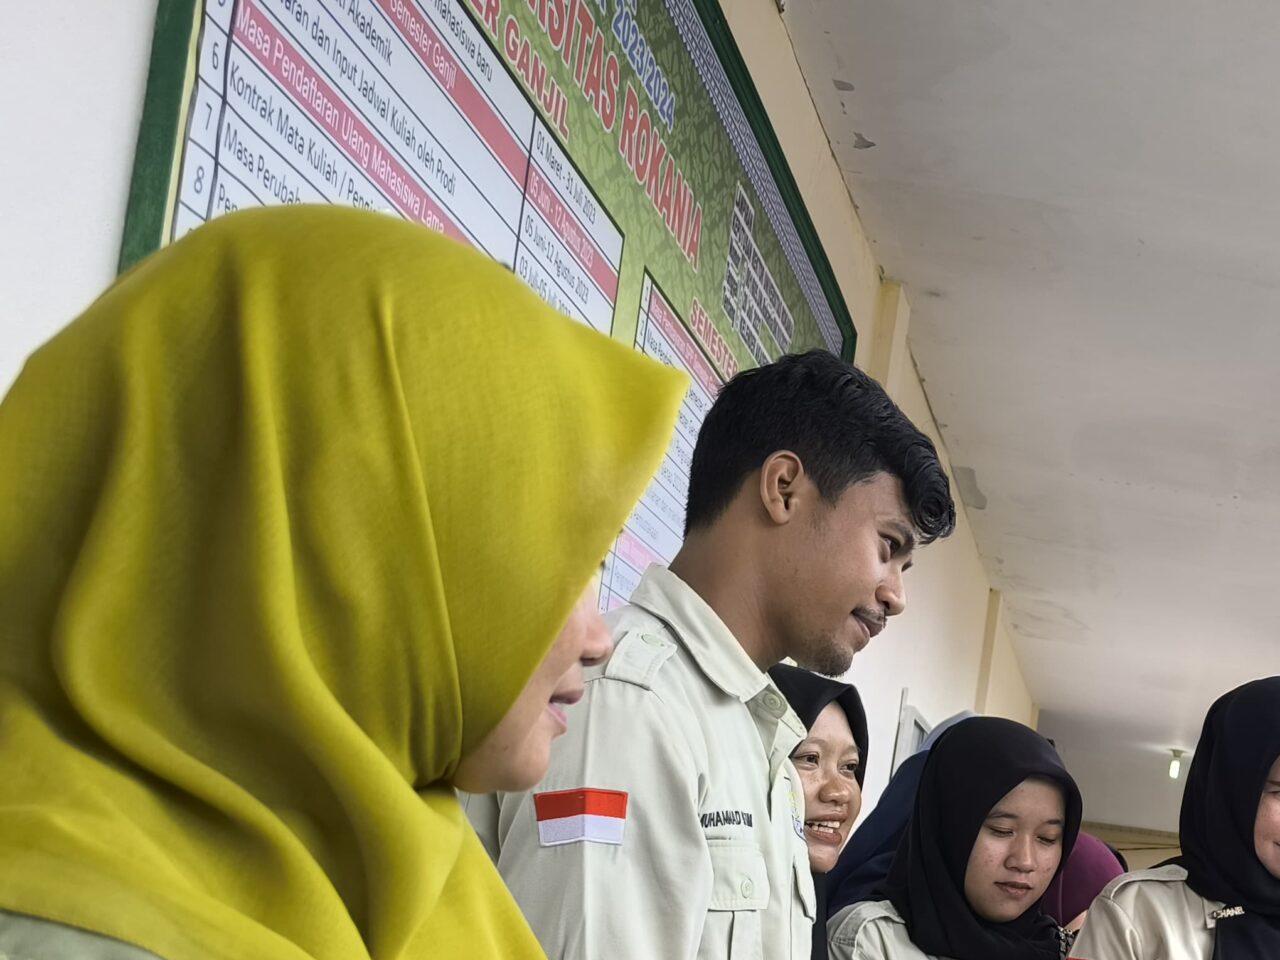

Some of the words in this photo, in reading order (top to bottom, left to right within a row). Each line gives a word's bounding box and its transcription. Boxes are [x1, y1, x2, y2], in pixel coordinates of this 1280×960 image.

[348, 2, 392, 67] Akademik
[432, 42, 457, 89] Ganjil
[476, 43, 493, 83] baru
[504, 16, 569, 143] GANJIL
[205, 102, 212, 131] 7
[224, 122, 253, 173] Masa
[256, 155, 303, 205] Perubah
[212, 42, 219, 70] 6
[229, 61, 275, 126] Kontrak
[276, 107, 304, 155] Mata
[306, 137, 338, 188] Kuliah
[236, 2, 271, 57] Masa
[273, 38, 340, 131] Pendaftaran
[341, 111, 370, 168] Ulang
[371, 144, 420, 216] Mahasiswa
[421, 197, 444, 234] Lama
[311, 15, 331, 56] dan
[332, 38, 358, 87] Input
[357, 70, 390, 119] Jadwal
[390, 105, 416, 153] Kuliah
[417, 140, 435, 173] oleh
[436, 159, 456, 197] Prodi
[527, 0, 619, 133] SITAS
[618, 81, 703, 273] ROKANIA
[194, 165, 204, 194] 8
[536, 131, 545, 156] 01
[545, 142, 563, 180] Maret
[565, 172, 573, 195] 31
[583, 194, 596, 224] 2023
[554, 253, 575, 290] Agustus
